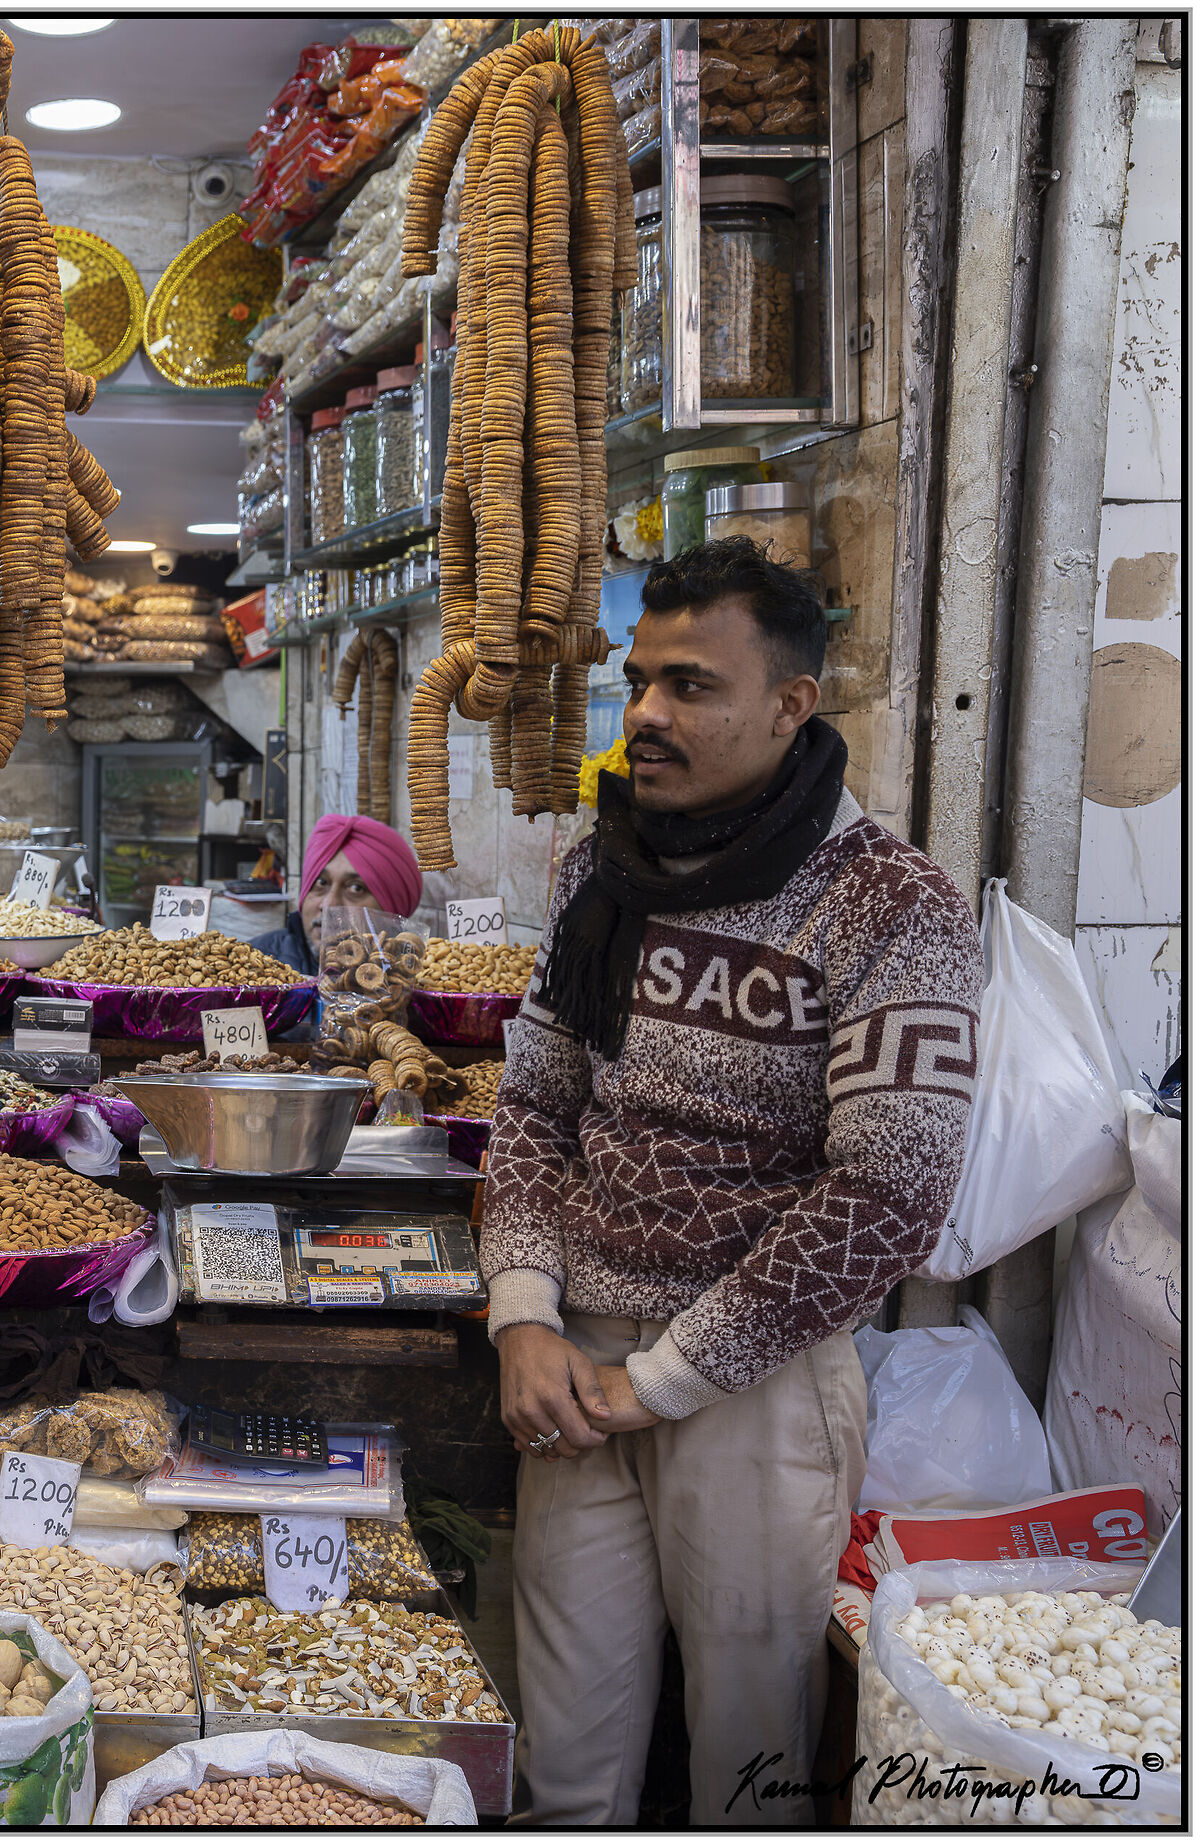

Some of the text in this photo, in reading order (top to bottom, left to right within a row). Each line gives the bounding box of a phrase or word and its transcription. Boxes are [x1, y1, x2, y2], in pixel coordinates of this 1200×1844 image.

[154, 899, 205, 918] 1200
[448, 904, 463, 917] Rs
[451, 912, 504, 939] 1200
[204, 1014, 225, 1025] Rs.
[210, 1283, 245, 1291] BHIM
[8, 1456, 26, 1473] Rs
[266, 1517, 290, 1535] Rs
